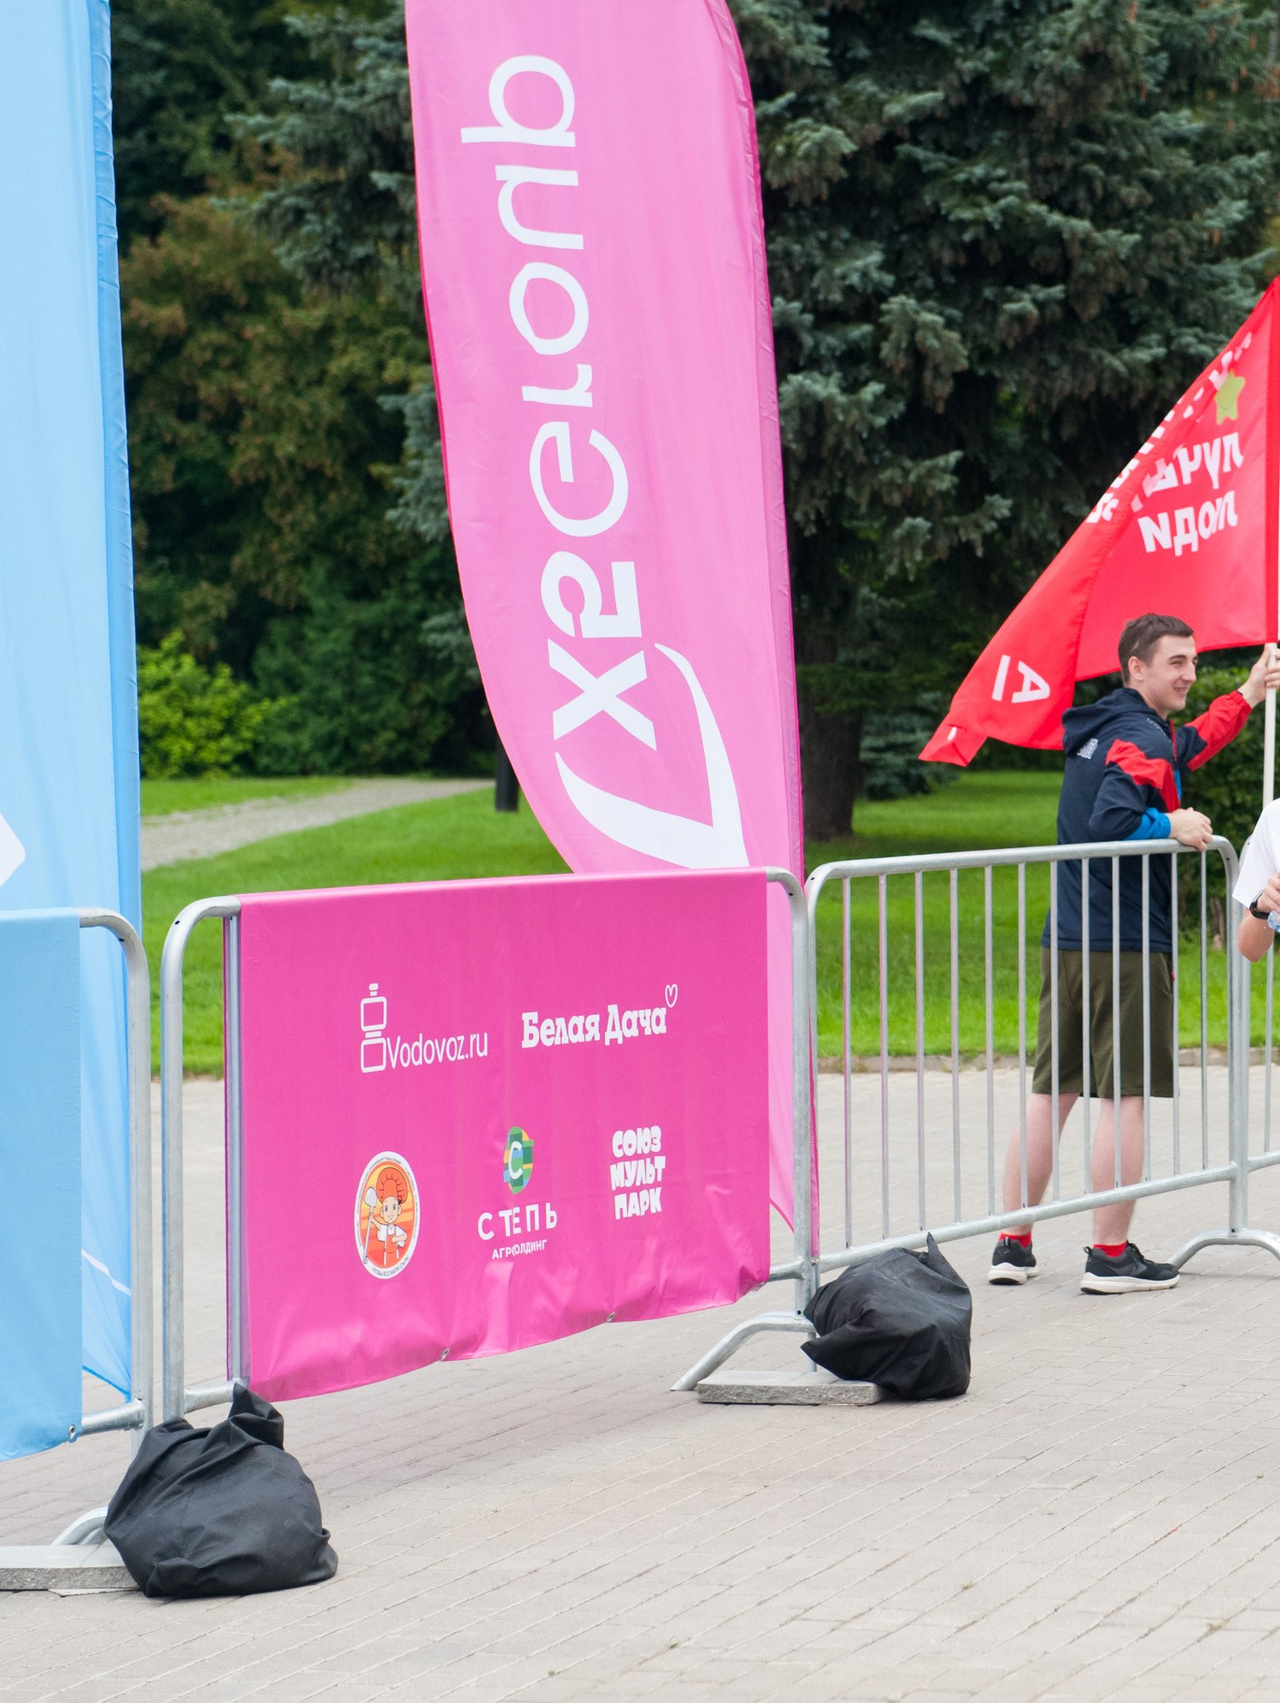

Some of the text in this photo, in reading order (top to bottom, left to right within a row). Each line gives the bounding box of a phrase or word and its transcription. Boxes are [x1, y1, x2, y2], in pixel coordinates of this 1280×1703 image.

[521, 1004, 667, 1048] Белая Дача
[385, 1032, 488, 1069] Vodovoz.ru
[612, 1125, 662, 1158] СОЮЗ
[610, 1155, 666, 1190] МУЛЬТ
[614, 1187, 662, 1220] ПАРК
